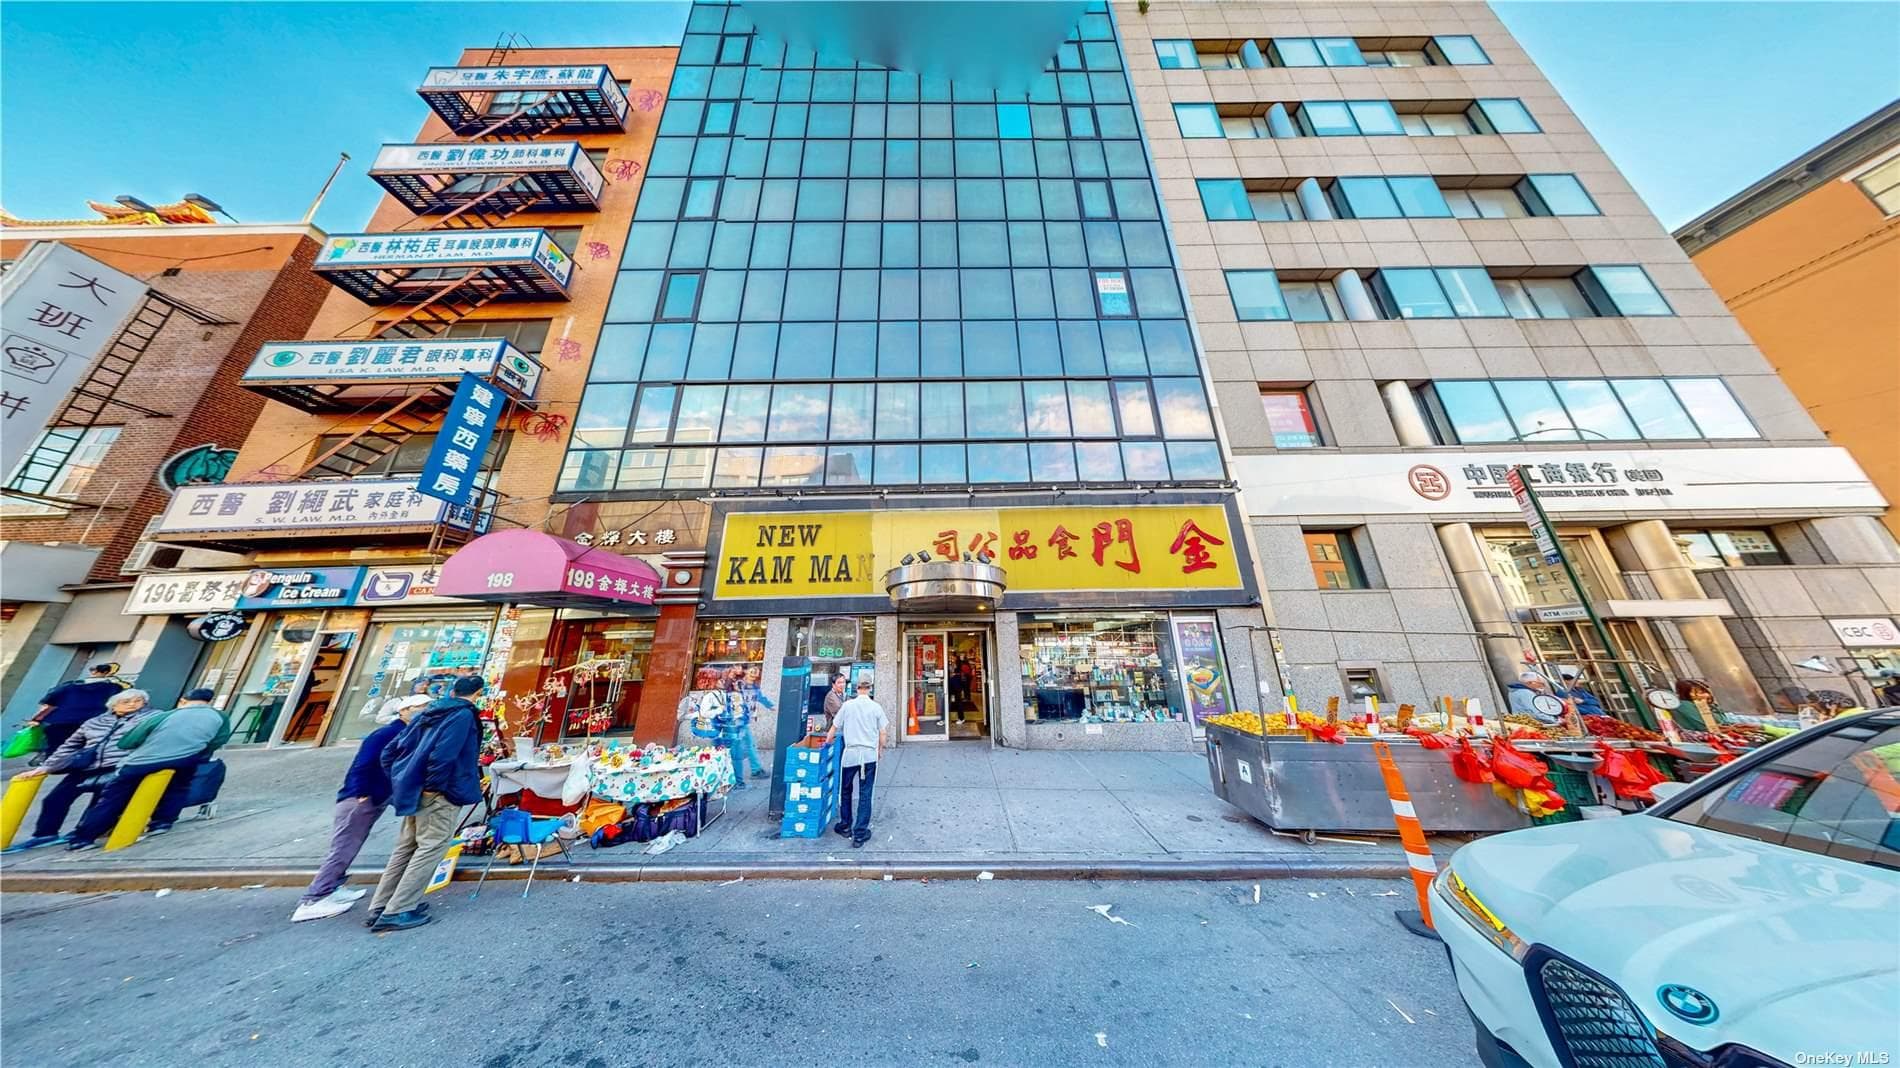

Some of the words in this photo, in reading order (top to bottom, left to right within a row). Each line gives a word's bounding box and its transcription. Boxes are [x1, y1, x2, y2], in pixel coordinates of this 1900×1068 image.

[308, 351, 343, 365] 西醫
[346, 346, 424, 366] 劉麗君
[425, 348, 494, 363] 眼科專科
[188, 492, 247, 516] 西醫
[266, 489, 357, 515] 劉繩武
[756, 524, 823, 547] NEW
[264, 571, 313, 585] Penguin
[487, 572, 514, 588] 198
[726, 556, 796, 585] KAM
[278, 587, 298, 600] Ice
[301, 587, 341, 599] Cream
